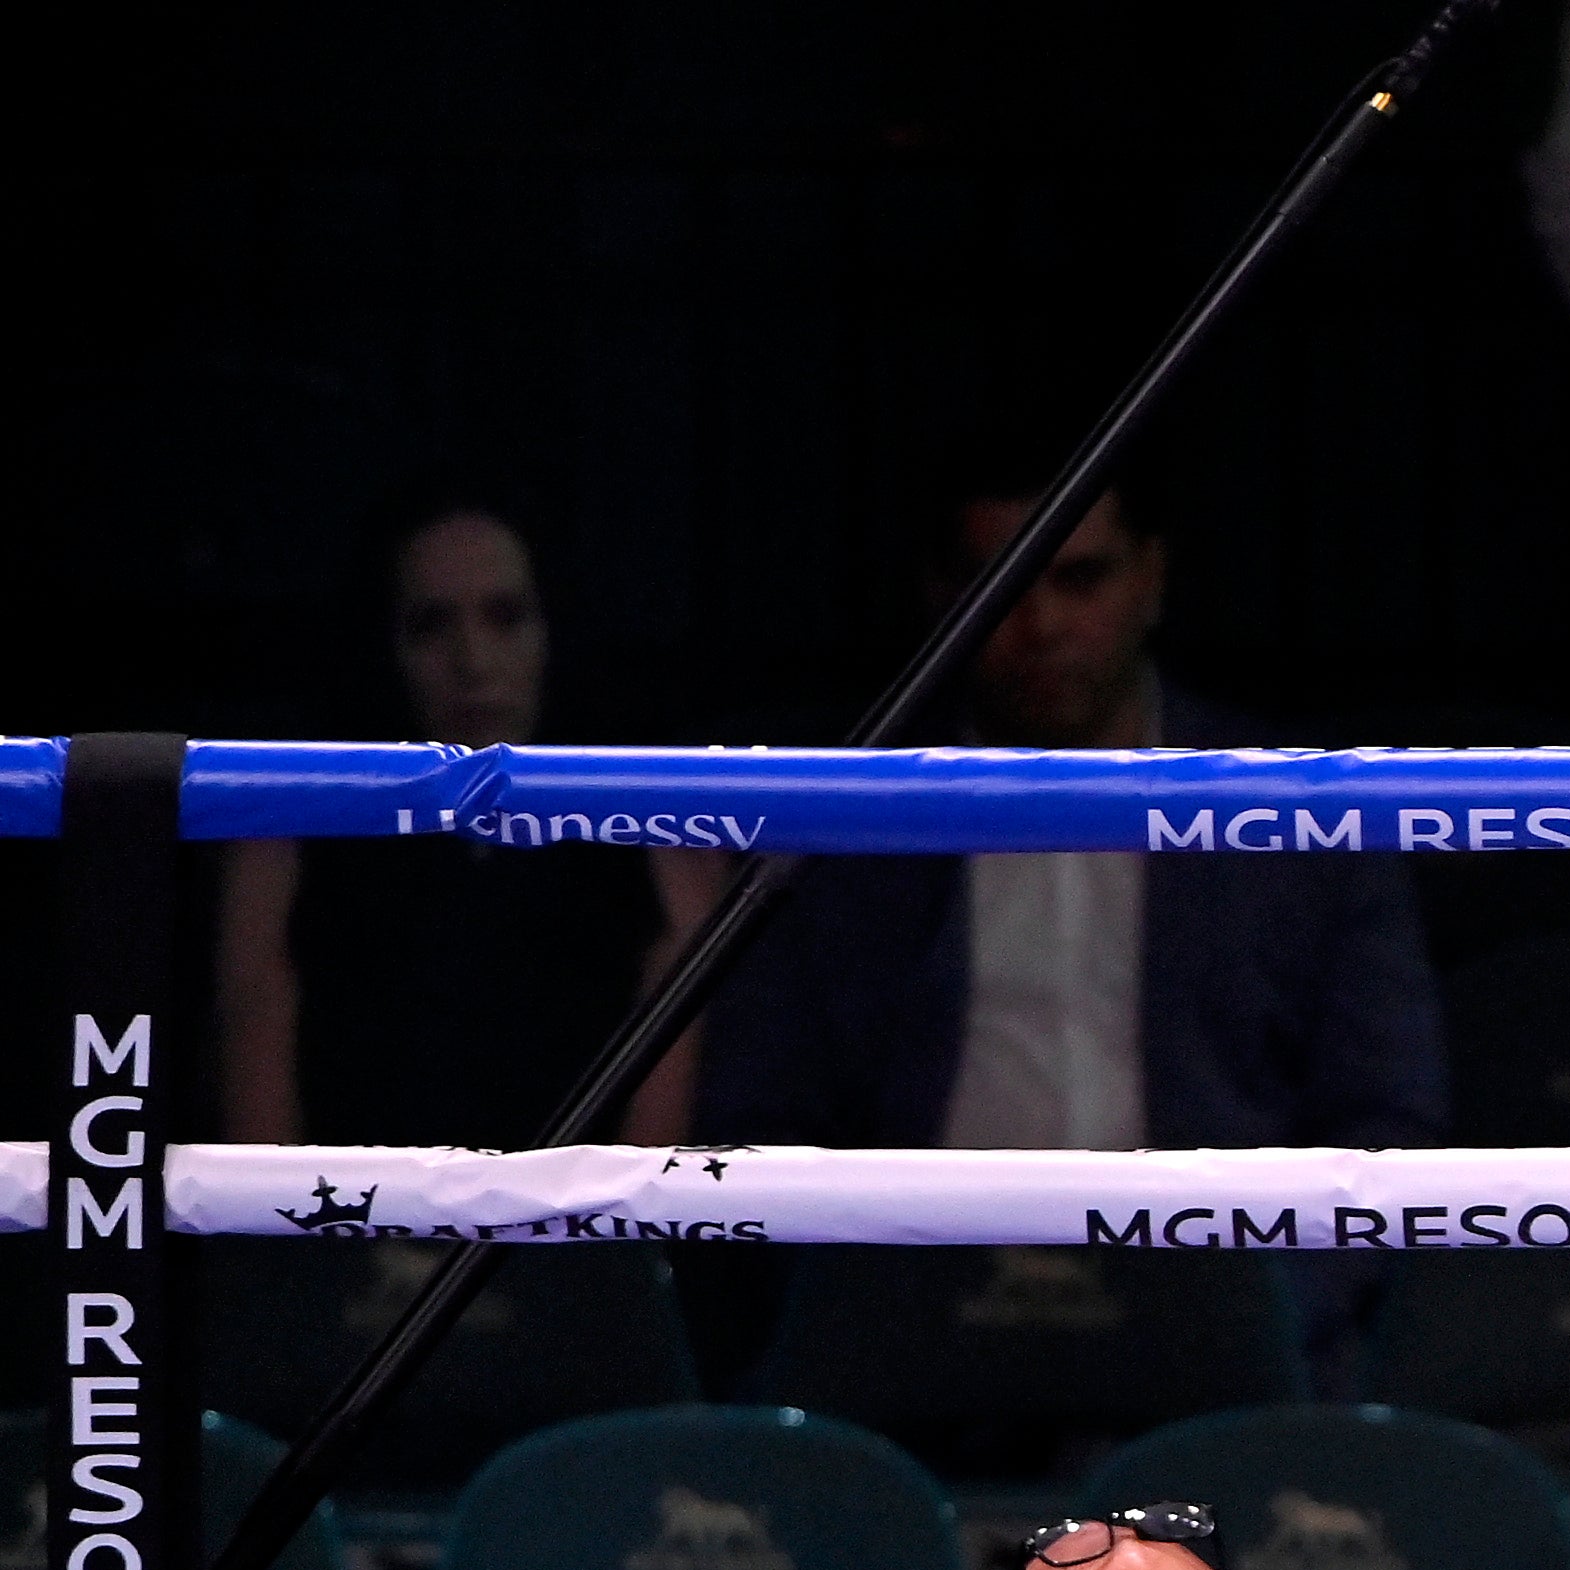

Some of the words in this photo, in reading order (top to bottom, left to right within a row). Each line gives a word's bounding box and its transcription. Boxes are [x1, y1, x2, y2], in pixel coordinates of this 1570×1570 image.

[1146, 808, 1361, 852] MGM
[66, 1013, 153, 1250] MGM
[1086, 1206, 1297, 1248] MGM
